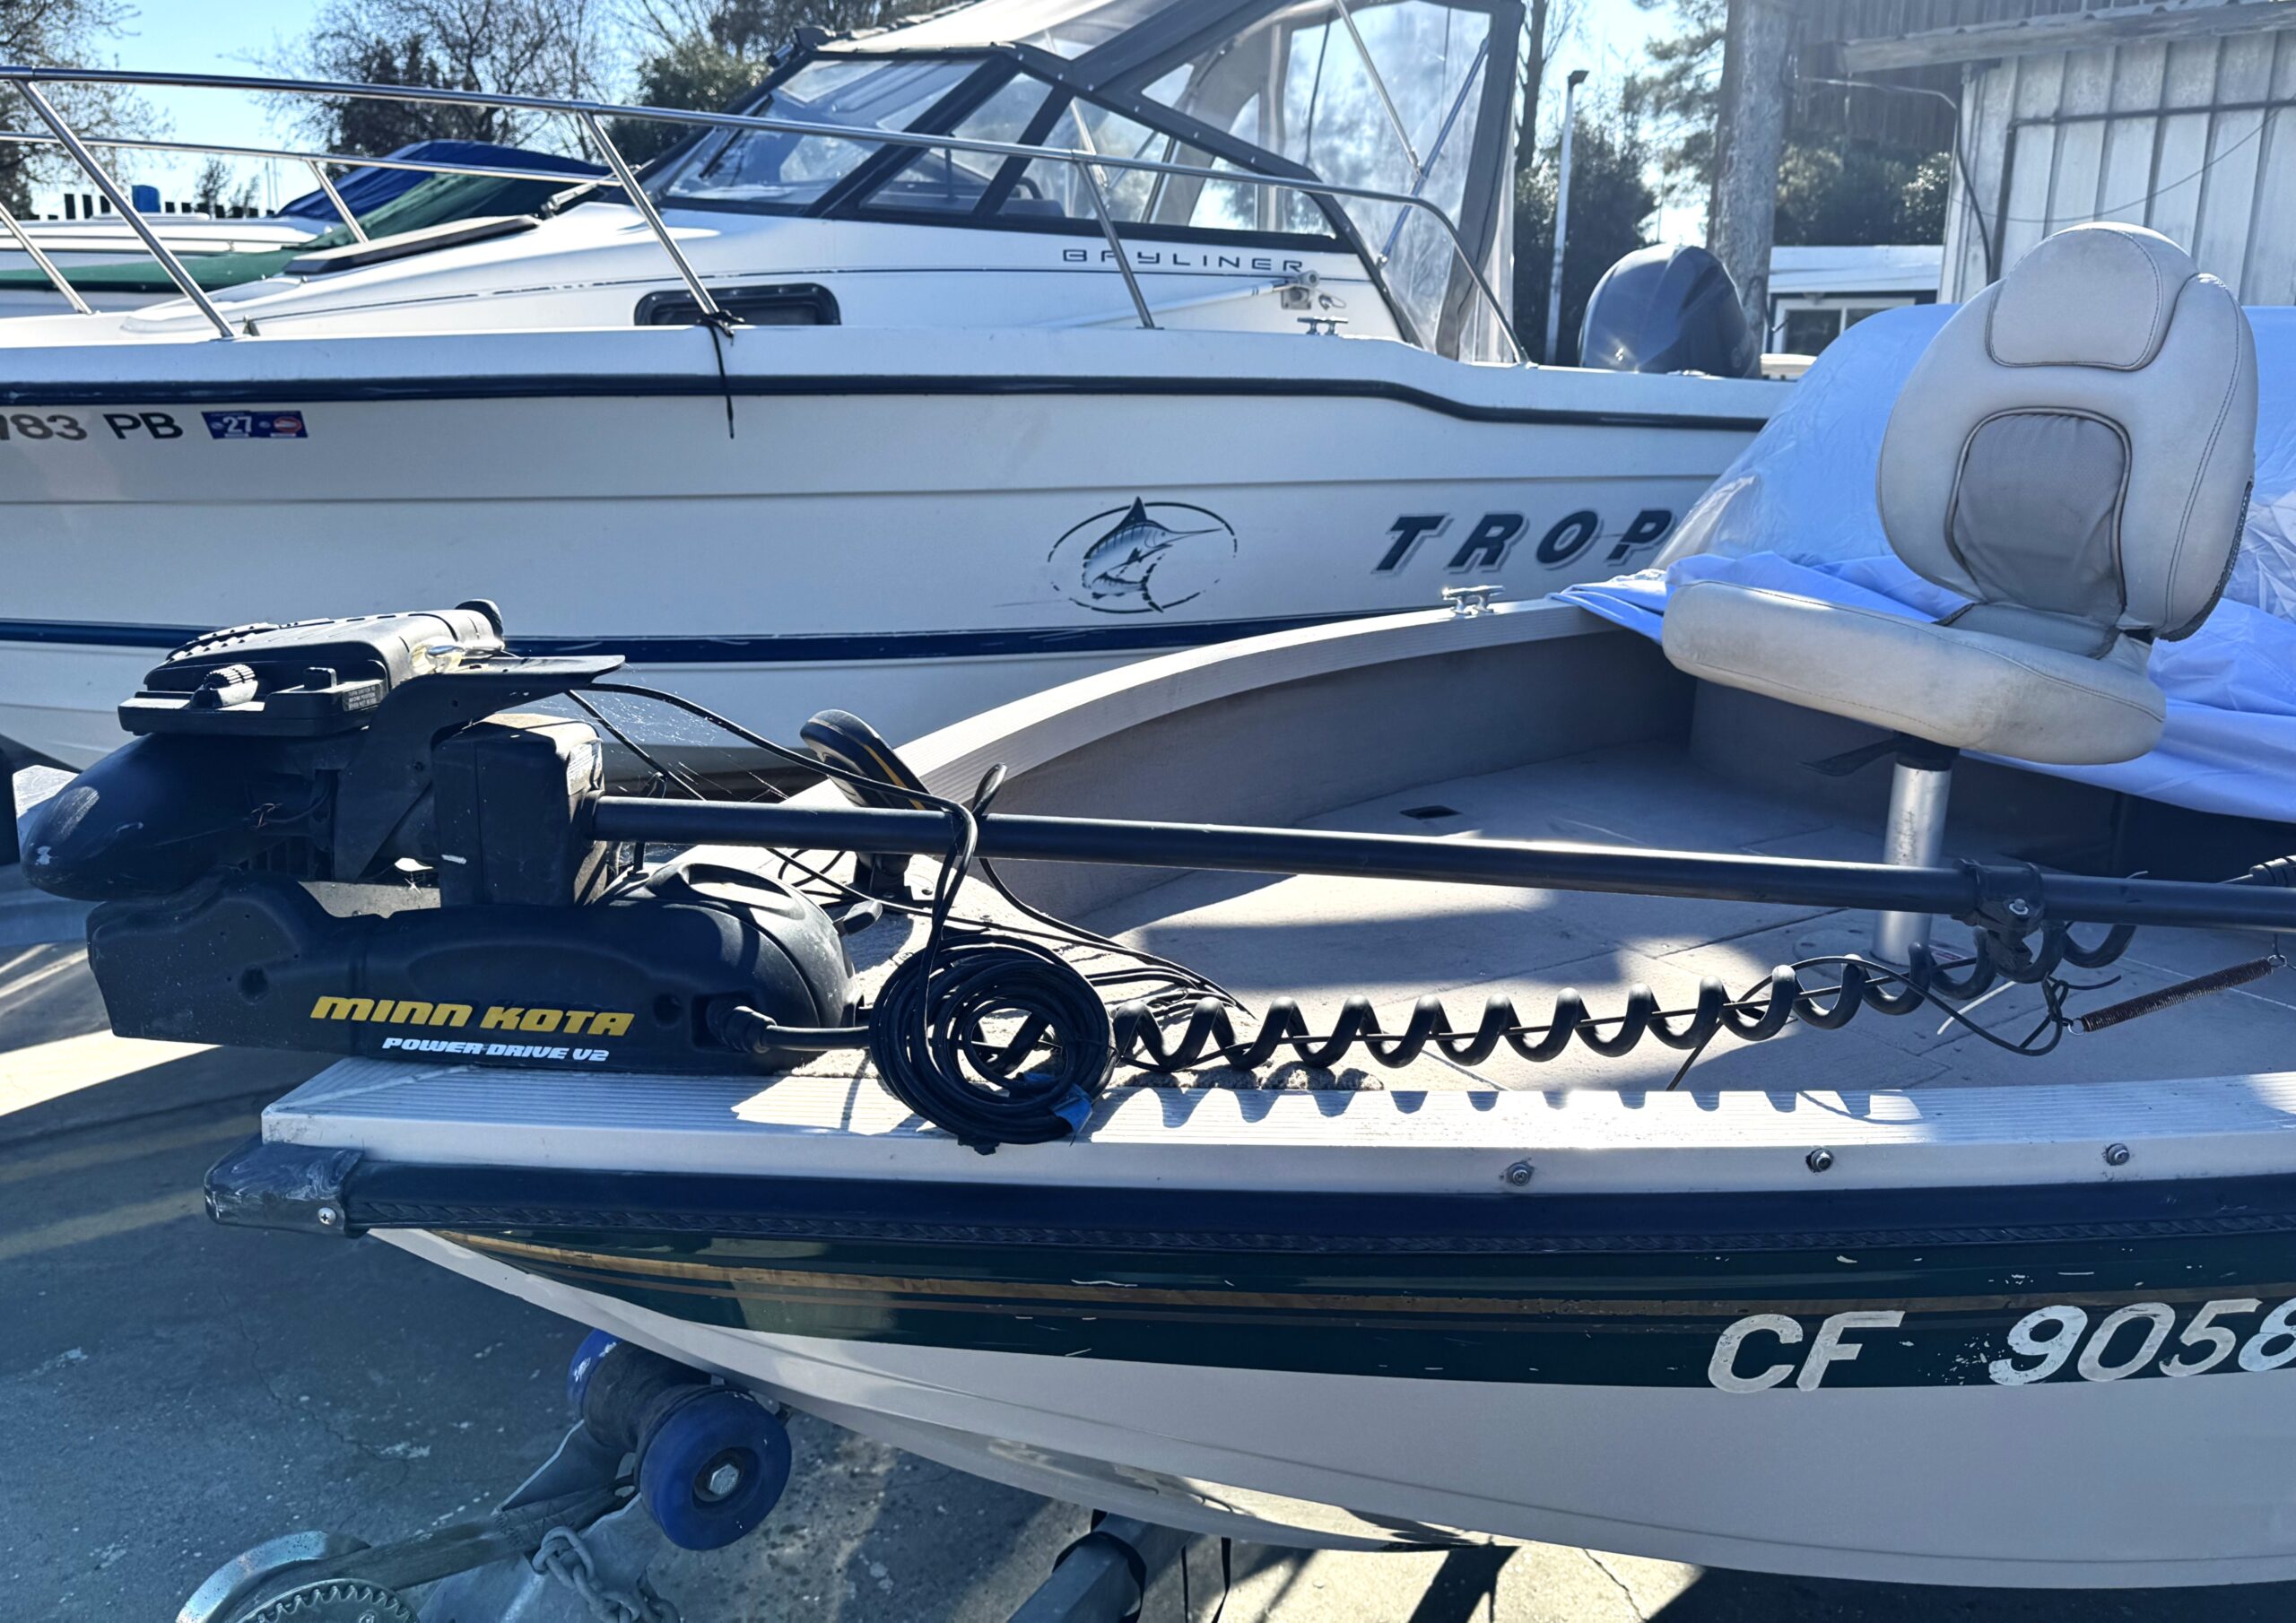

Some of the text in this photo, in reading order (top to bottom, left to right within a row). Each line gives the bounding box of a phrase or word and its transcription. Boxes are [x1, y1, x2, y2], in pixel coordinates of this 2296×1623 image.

[102, 412, 184, 439] PB
[222, 415, 253, 434] 27
[310, 995, 635, 1037] MINN KOTA
[572, 1048, 610, 1062] V2
[1708, 1298, 2296, 1394] CF 9058
